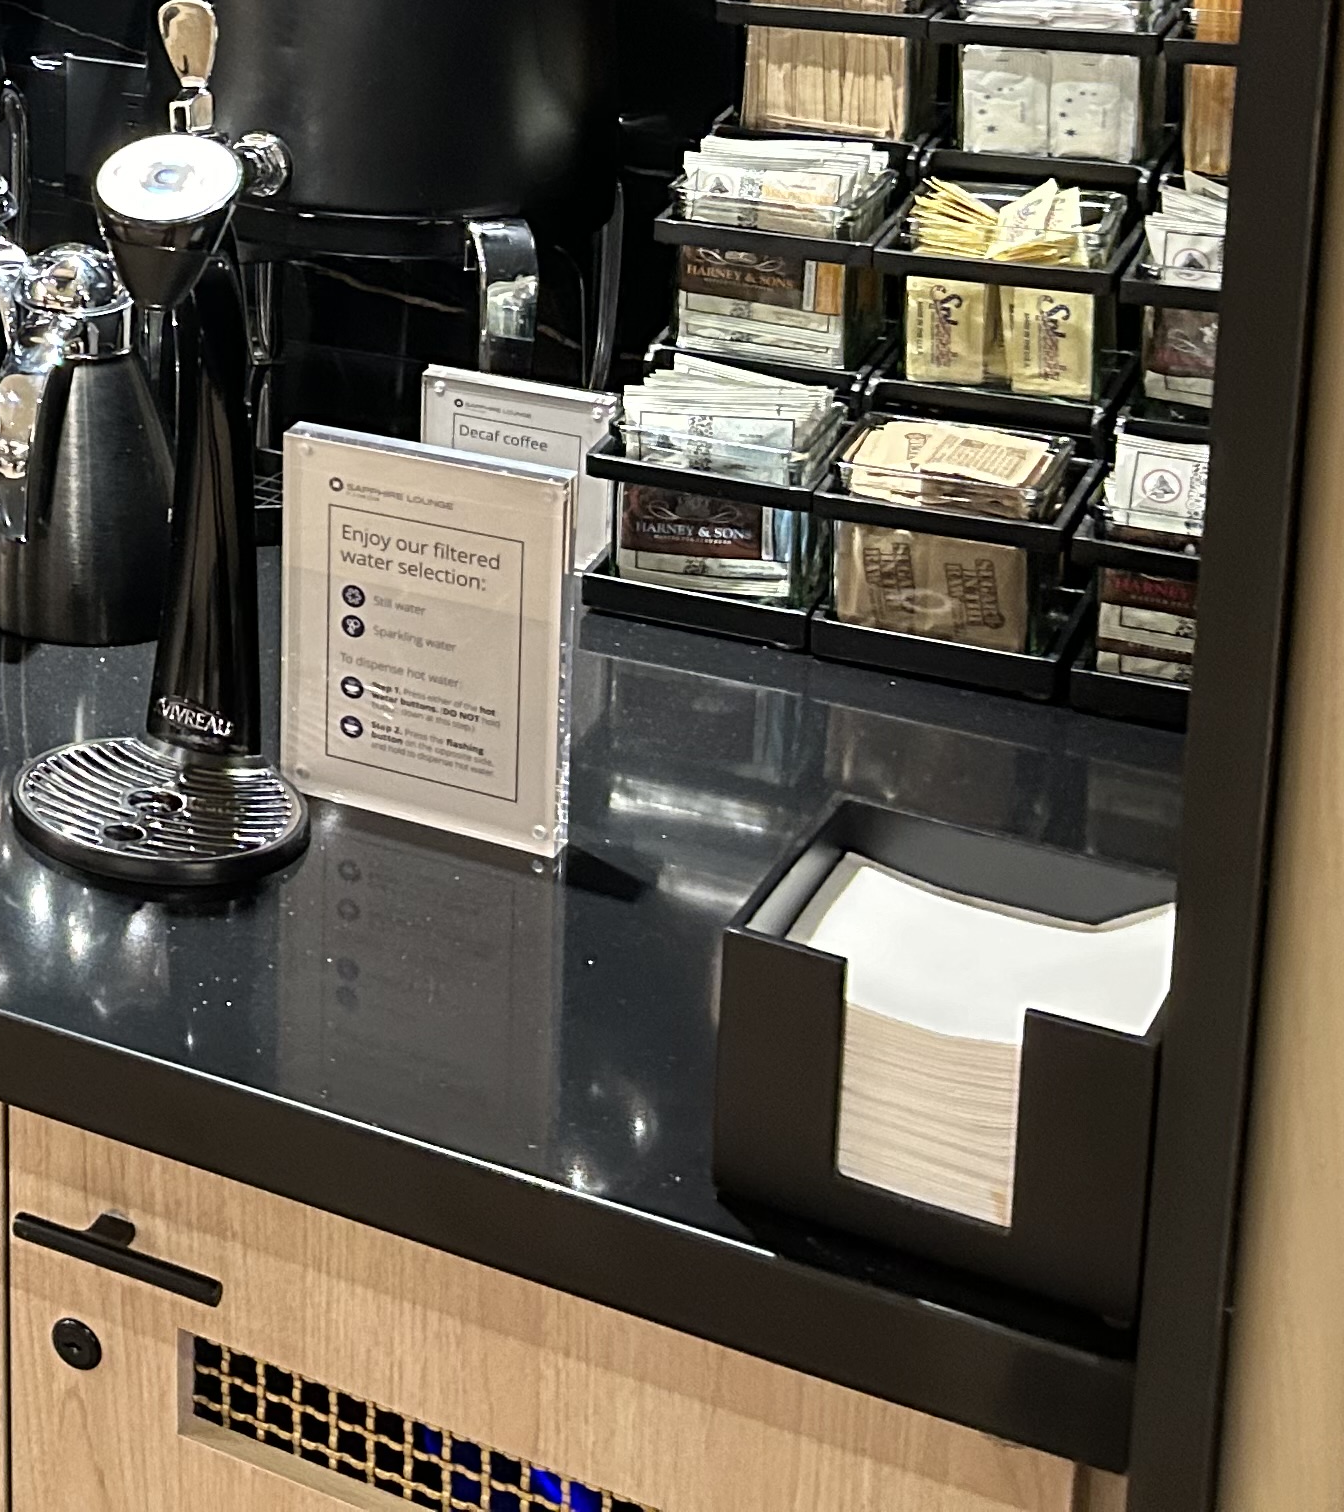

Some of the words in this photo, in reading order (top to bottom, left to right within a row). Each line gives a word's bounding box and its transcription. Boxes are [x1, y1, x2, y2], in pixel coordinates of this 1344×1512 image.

[686, 262, 742, 281] HARNEY
[459, 424, 501, 442] Decaf
[502, 433, 549, 452] coffee
[346, 483, 404, 501] SAPPHIRE
[406, 494, 454, 510] LOUNGE
[635, 520, 695, 538] HARNEY
[697, 526, 712, 538] &
[712, 527, 753, 541] SONS
[341, 523, 392, 552] Enjoy
[395, 537, 429, 556] our
[433, 541, 501, 570] filtered
[340, 549, 394, 571] water
[397, 561, 487, 592] selection:
[372, 595, 393, 608] Still
[394, 601, 426, 616] water
[372, 624, 424, 648] Sparkling
[425, 638, 457, 652] water
[340, 651, 353, 665] To
[355, 656, 405, 676] dispense
[406, 667, 426, 682] hot
[158, 696, 232, 737] VIVREAU
[459, 711, 480, 723] NOT
[479, 704, 496, 717] hot
[446, 738, 484, 756] flashing
